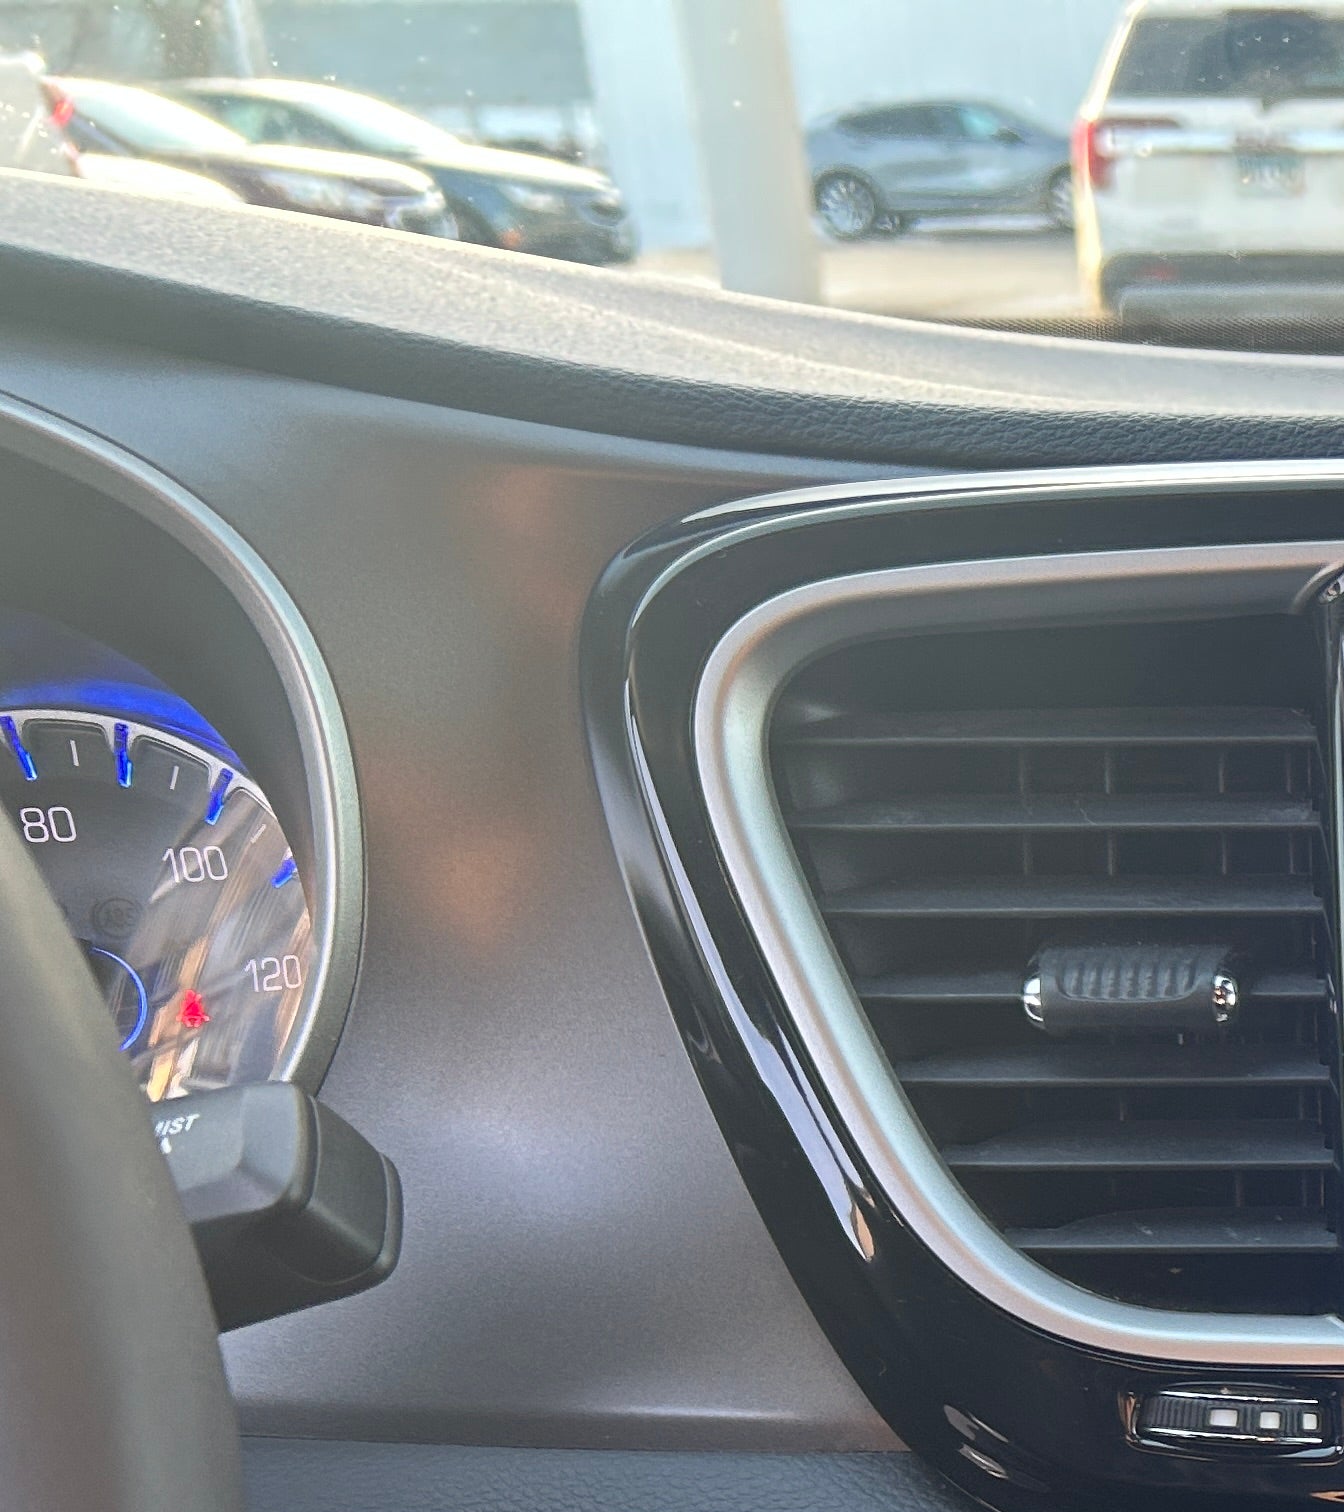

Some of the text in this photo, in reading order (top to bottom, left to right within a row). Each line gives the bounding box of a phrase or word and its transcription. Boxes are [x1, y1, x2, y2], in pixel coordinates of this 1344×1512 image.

[20, 806, 77, 843] 80
[162, 845, 229, 883] 100
[244, 953, 302, 993] 120
